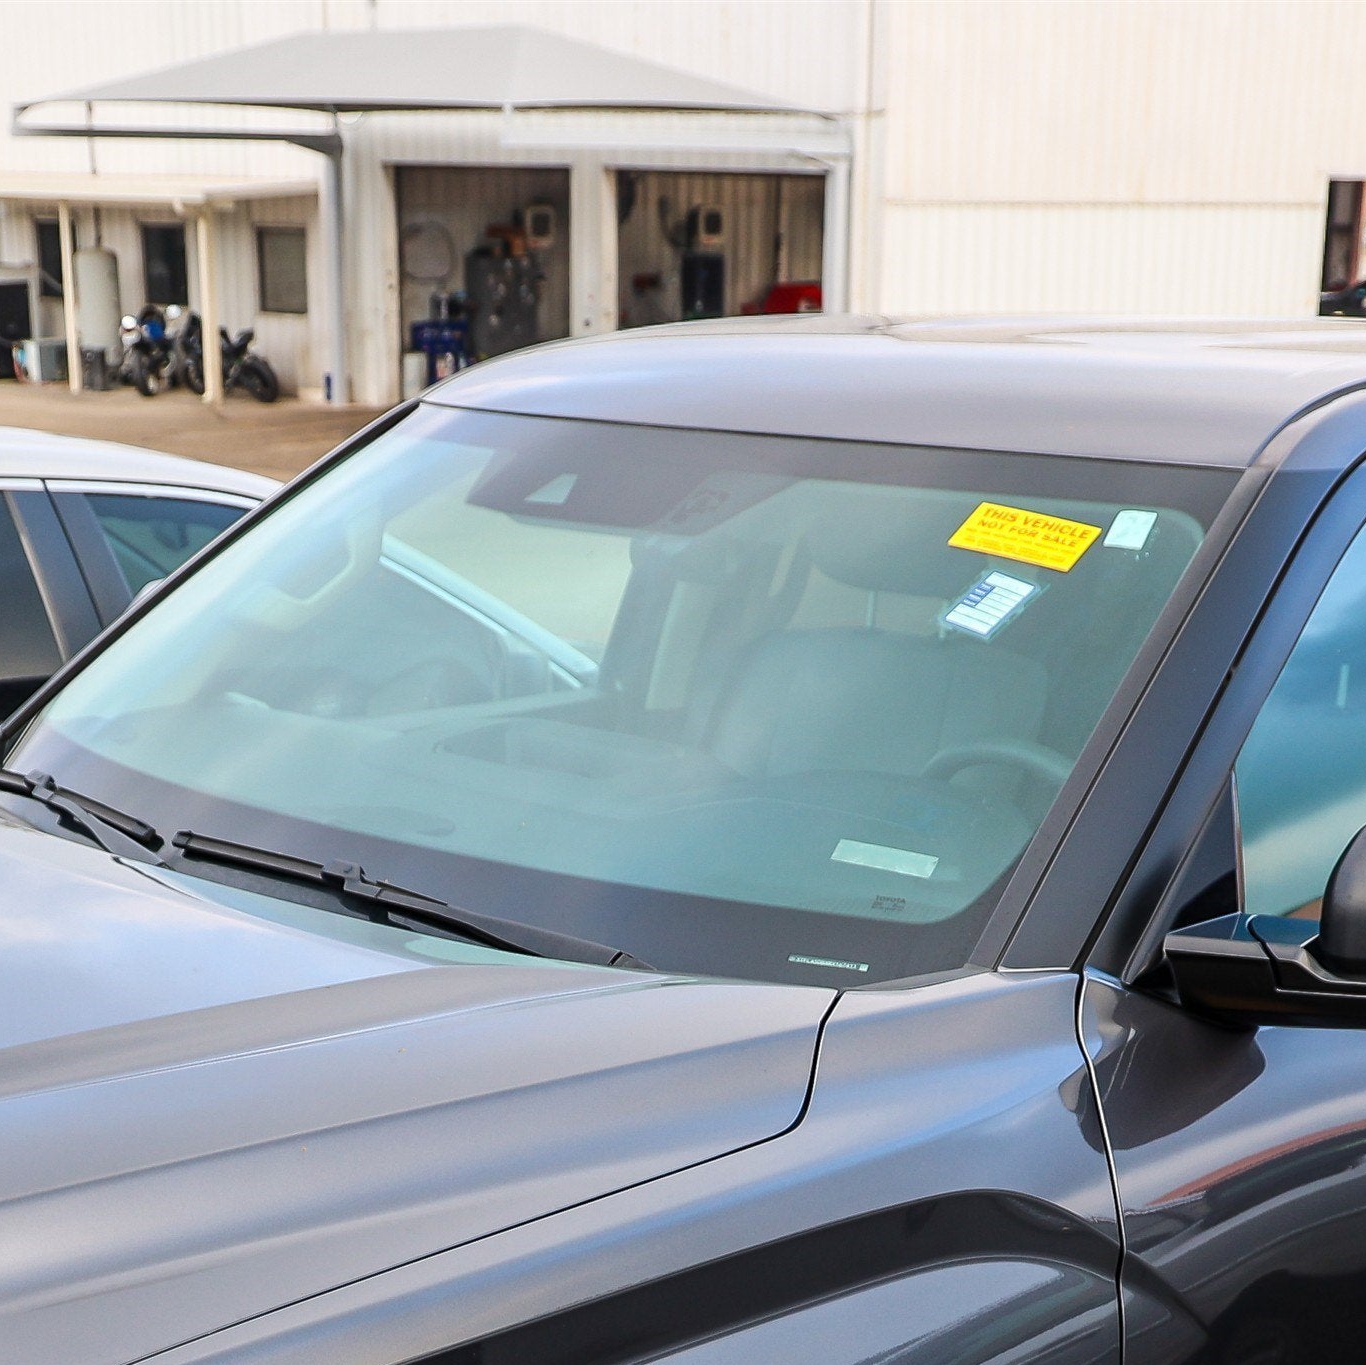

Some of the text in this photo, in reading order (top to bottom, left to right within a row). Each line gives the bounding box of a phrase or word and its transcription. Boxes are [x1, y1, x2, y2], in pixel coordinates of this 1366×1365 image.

[977, 518, 1007, 531] NOT
[1008, 526, 1039, 538] FOR
[1041, 533, 1078, 548] SALE
[983, 507, 1093, 540] THIS VEHICLE
